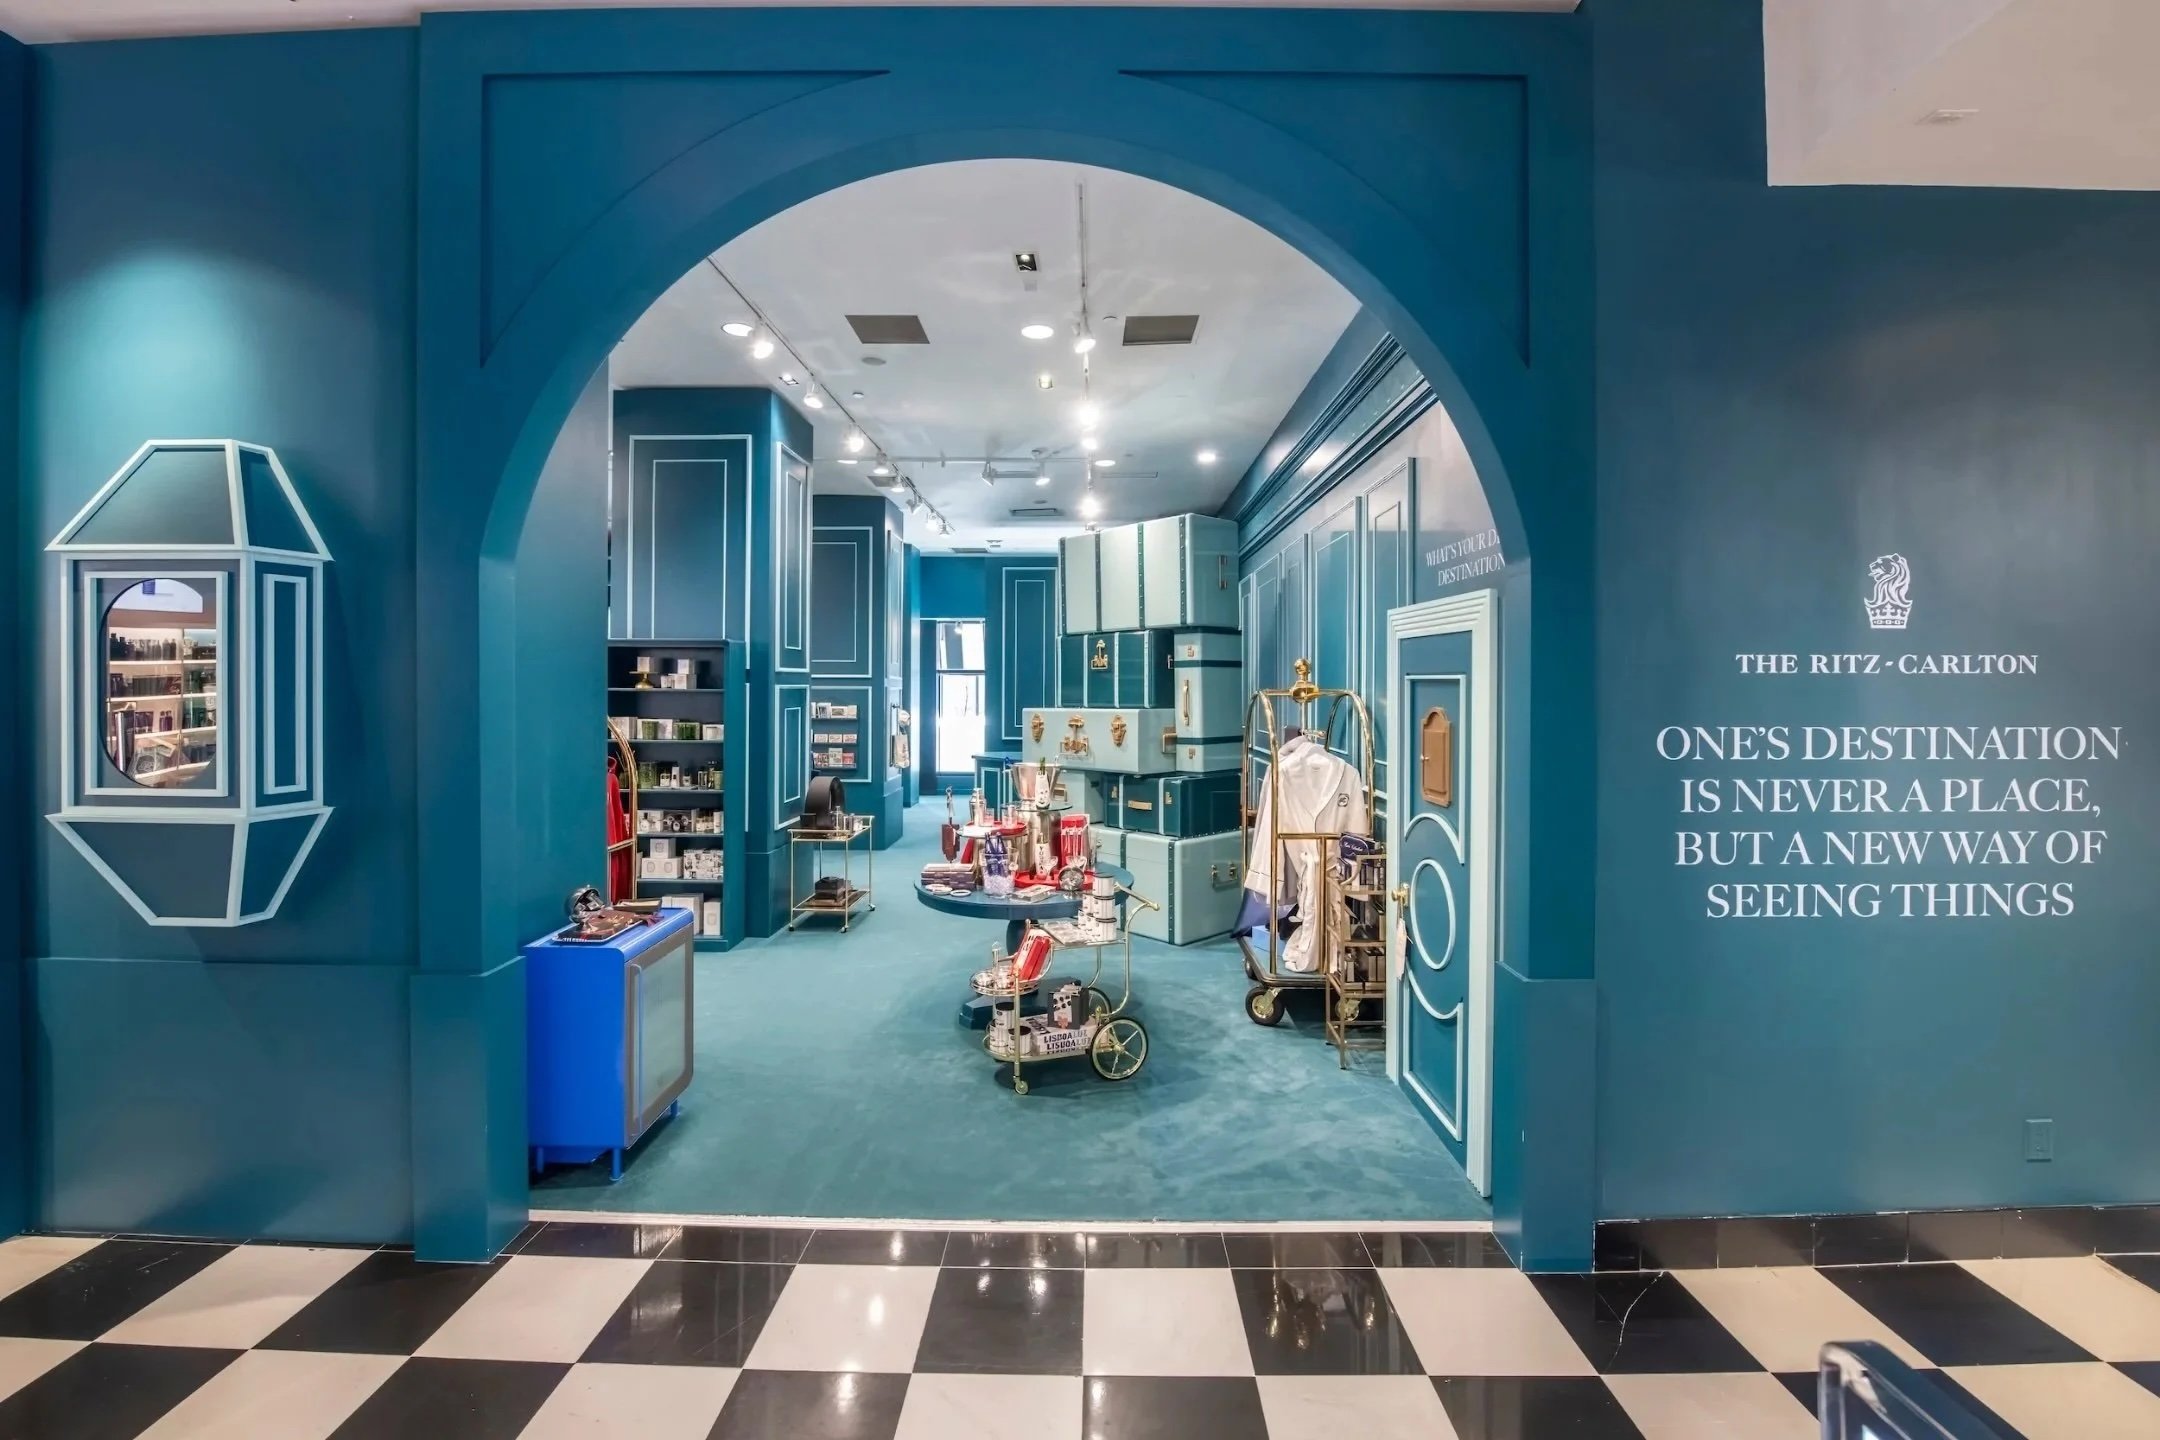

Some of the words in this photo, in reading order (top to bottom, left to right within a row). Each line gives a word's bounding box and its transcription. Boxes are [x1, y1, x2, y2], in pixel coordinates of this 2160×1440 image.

[1457, 532, 1486, 557] YOUR
[1438, 552, 1506, 587] DESTINATION
[1735, 653, 1799, 675] THE
[1656, 725, 1790, 761] ONE'S
[1801, 725, 2123, 761] DESTINATION
[1680, 778, 1721, 813] IS
[1731, 778, 1893, 813] NEVER
[1896, 778, 1933, 813] A
[1941, 777, 2101, 818] PLACE,
[1674, 831, 1774, 866] BUT
[1779, 831, 1815, 865] A
[1821, 831, 1934, 865] NEW
[1938, 830, 2039, 865] WAY
[2045, 830, 2108, 865] OF
[1706, 883, 1883, 919] SEEING
[1890, 882, 2075, 917] THINGS
